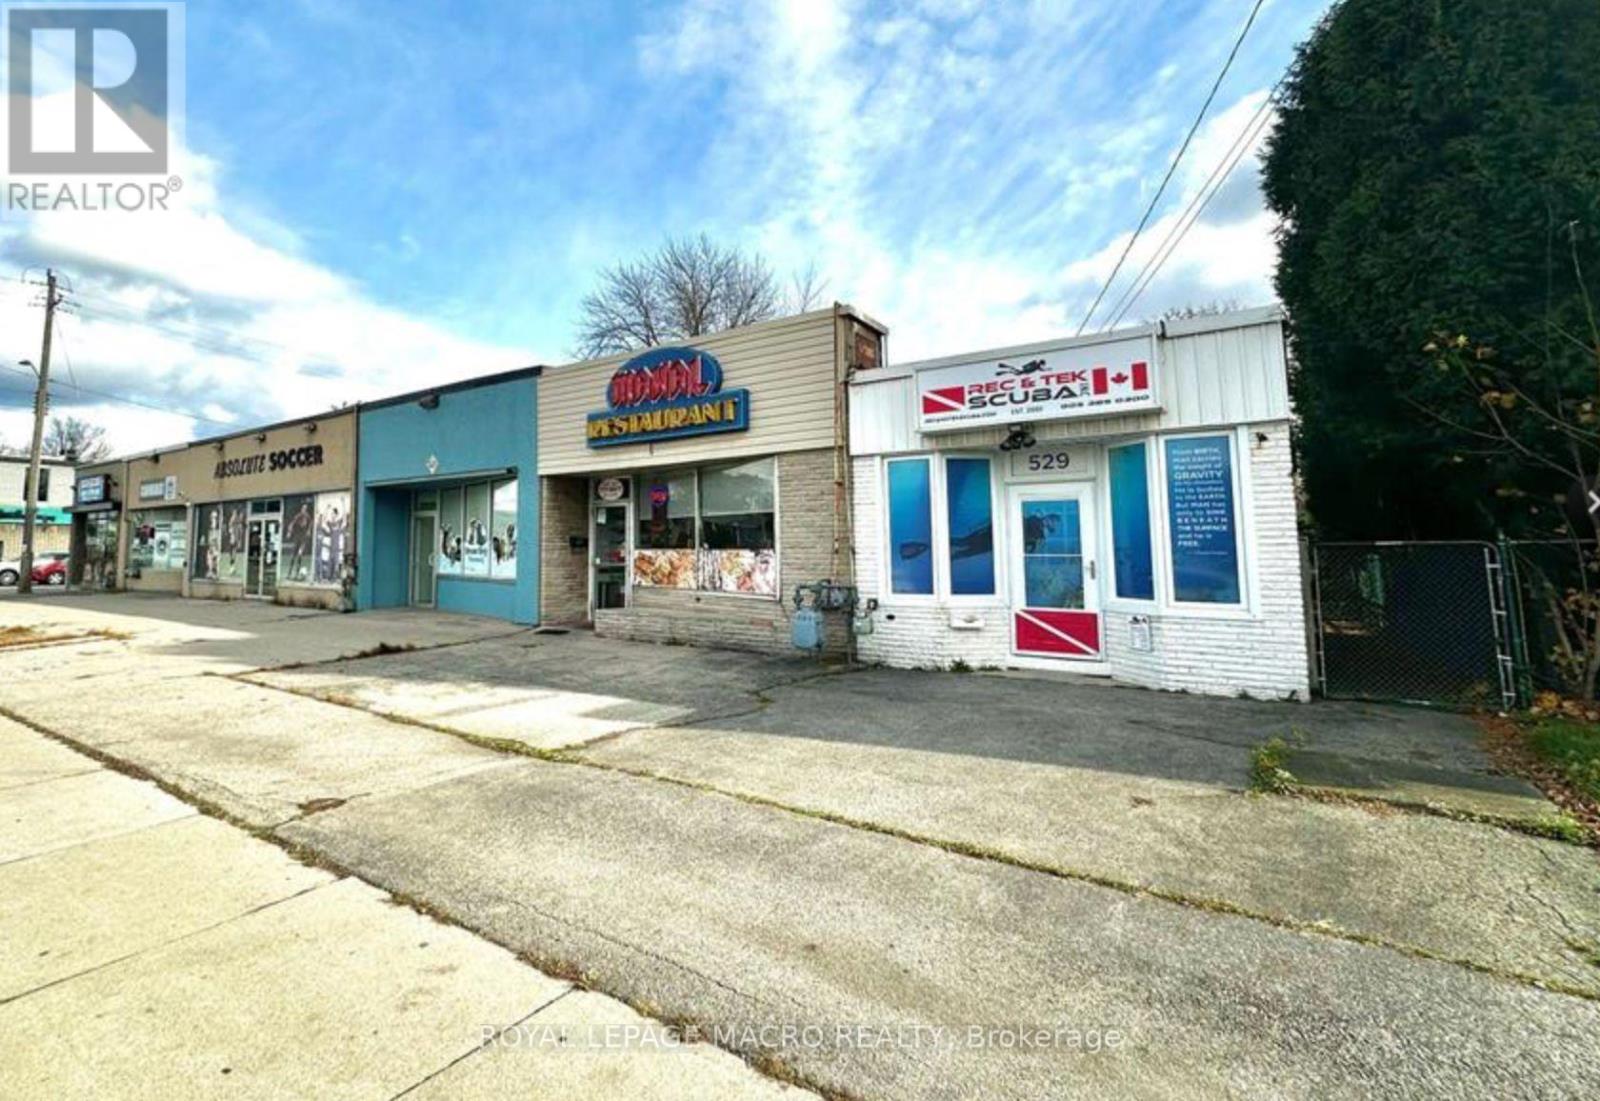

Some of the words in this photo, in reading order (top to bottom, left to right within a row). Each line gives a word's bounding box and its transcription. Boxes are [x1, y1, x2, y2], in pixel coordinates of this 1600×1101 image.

[968, 378, 1015, 395] REC
[1021, 377, 1035, 389] &
[1040, 369, 1087, 386] TEK
[968, 385, 1078, 410] SCUBA
[588, 398, 737, 438] RESTAURANT
[214, 454, 266, 479] ABSOLUTE
[269, 444, 323, 472] SOCCER
[1029, 452, 1070, 471] 529
[1174, 471, 1223, 479] GRAVITY
